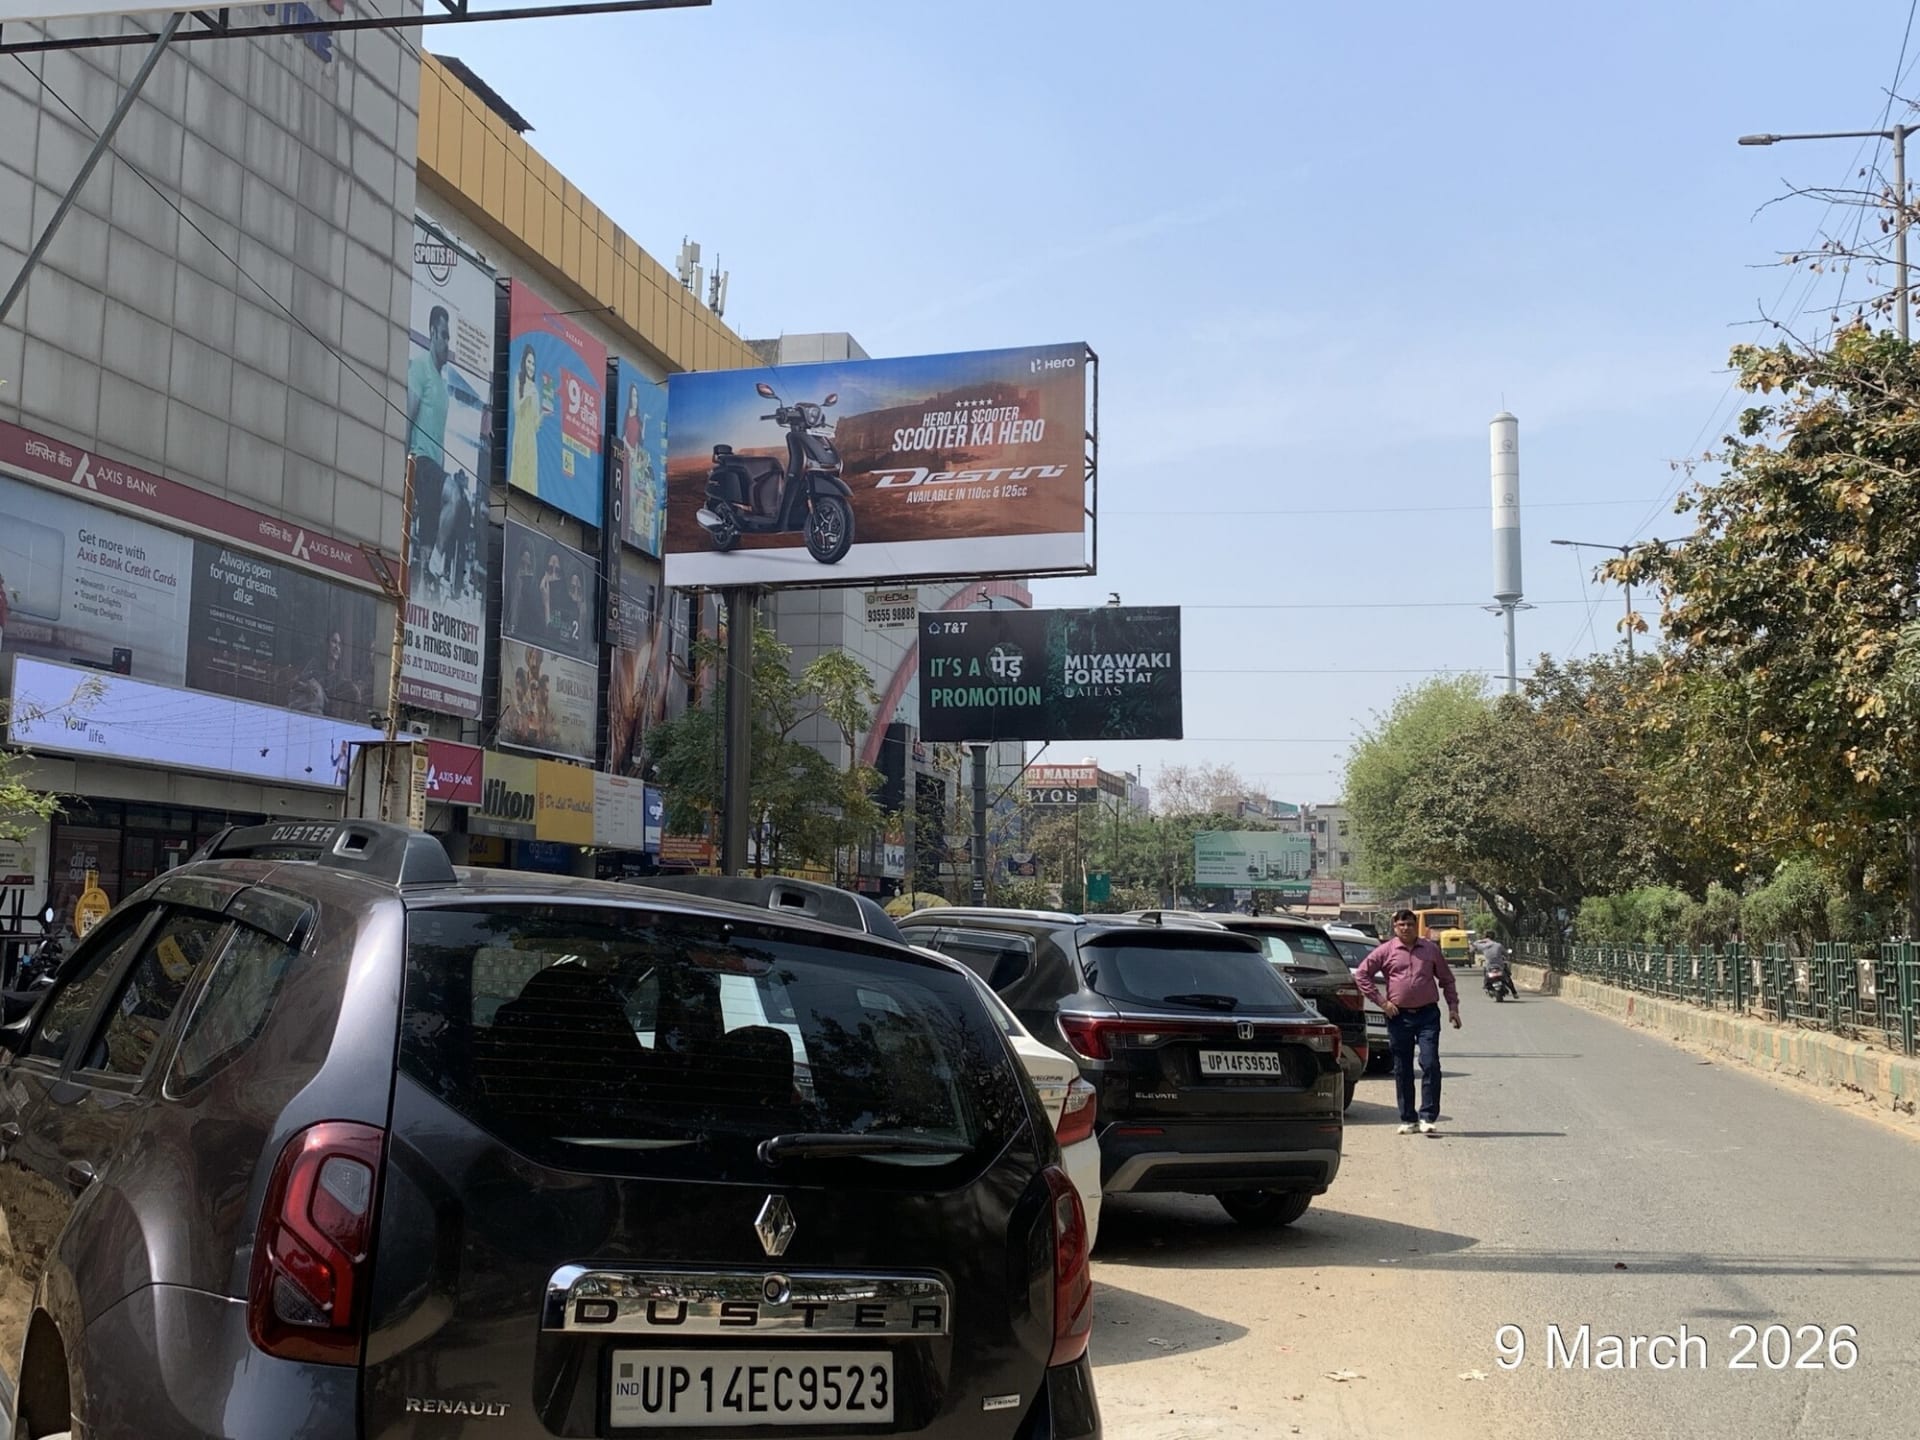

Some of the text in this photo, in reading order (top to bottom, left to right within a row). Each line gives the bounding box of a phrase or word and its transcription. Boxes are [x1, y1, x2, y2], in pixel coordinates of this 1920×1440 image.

[415, 244, 445, 265] SPORTS
[923, 406, 1020, 427] HERO KA SCOOTER
[892, 419, 1045, 452] SCOOTER KA HERO
[97, 467, 158, 497] AXIS BANK
[906, 484, 1027, 503] AVAILABLE IN 110cc & 125cc
[78, 529, 146, 561] Get more with
[309, 540, 352, 564] AXIS BANK
[77, 547, 177, 587] Axis Bank Credit Cards
[210, 564, 224, 580] for
[225, 571, 245, 587] your
[219, 550, 272, 580] Always open
[233, 588, 244, 603] dil
[432, 611, 480, 646] SPORTSFIT
[944, 622, 968, 634] T&T
[415, 635, 421, 650] &
[423, 635, 451, 659] FITNESS
[454, 645, 479, 668] STUDIO
[1064, 652, 1172, 670] MIYAWAKI
[930, 657, 981, 678] IT'S A
[990, 647, 1023, 683] पेड़
[1064, 668, 1152, 685] FOREST AT
[931, 686, 1041, 708] PROMOTION
[1077, 686, 1122, 697] ATLAS
[63, 714, 88, 732] Your
[88, 730, 106, 745] life.
[438, 771, 454, 784] AXIS
[455, 773, 473, 785] BANK
[1043, 768, 1095, 780] MARKET
[474, 778, 535, 821] Nikon
[271, 826, 336, 842] DUSTER
[1208, 1053, 1280, 1072] UP14FS9636
[1135, 1092, 1178, 1100] ELEVATE
[574, 1299, 943, 1329] DUSTER
[616, 1383, 639, 1396] IND
[641, 1364, 889, 1414] UP14EC9523
[405, 1398, 510, 1417] RENAULT
